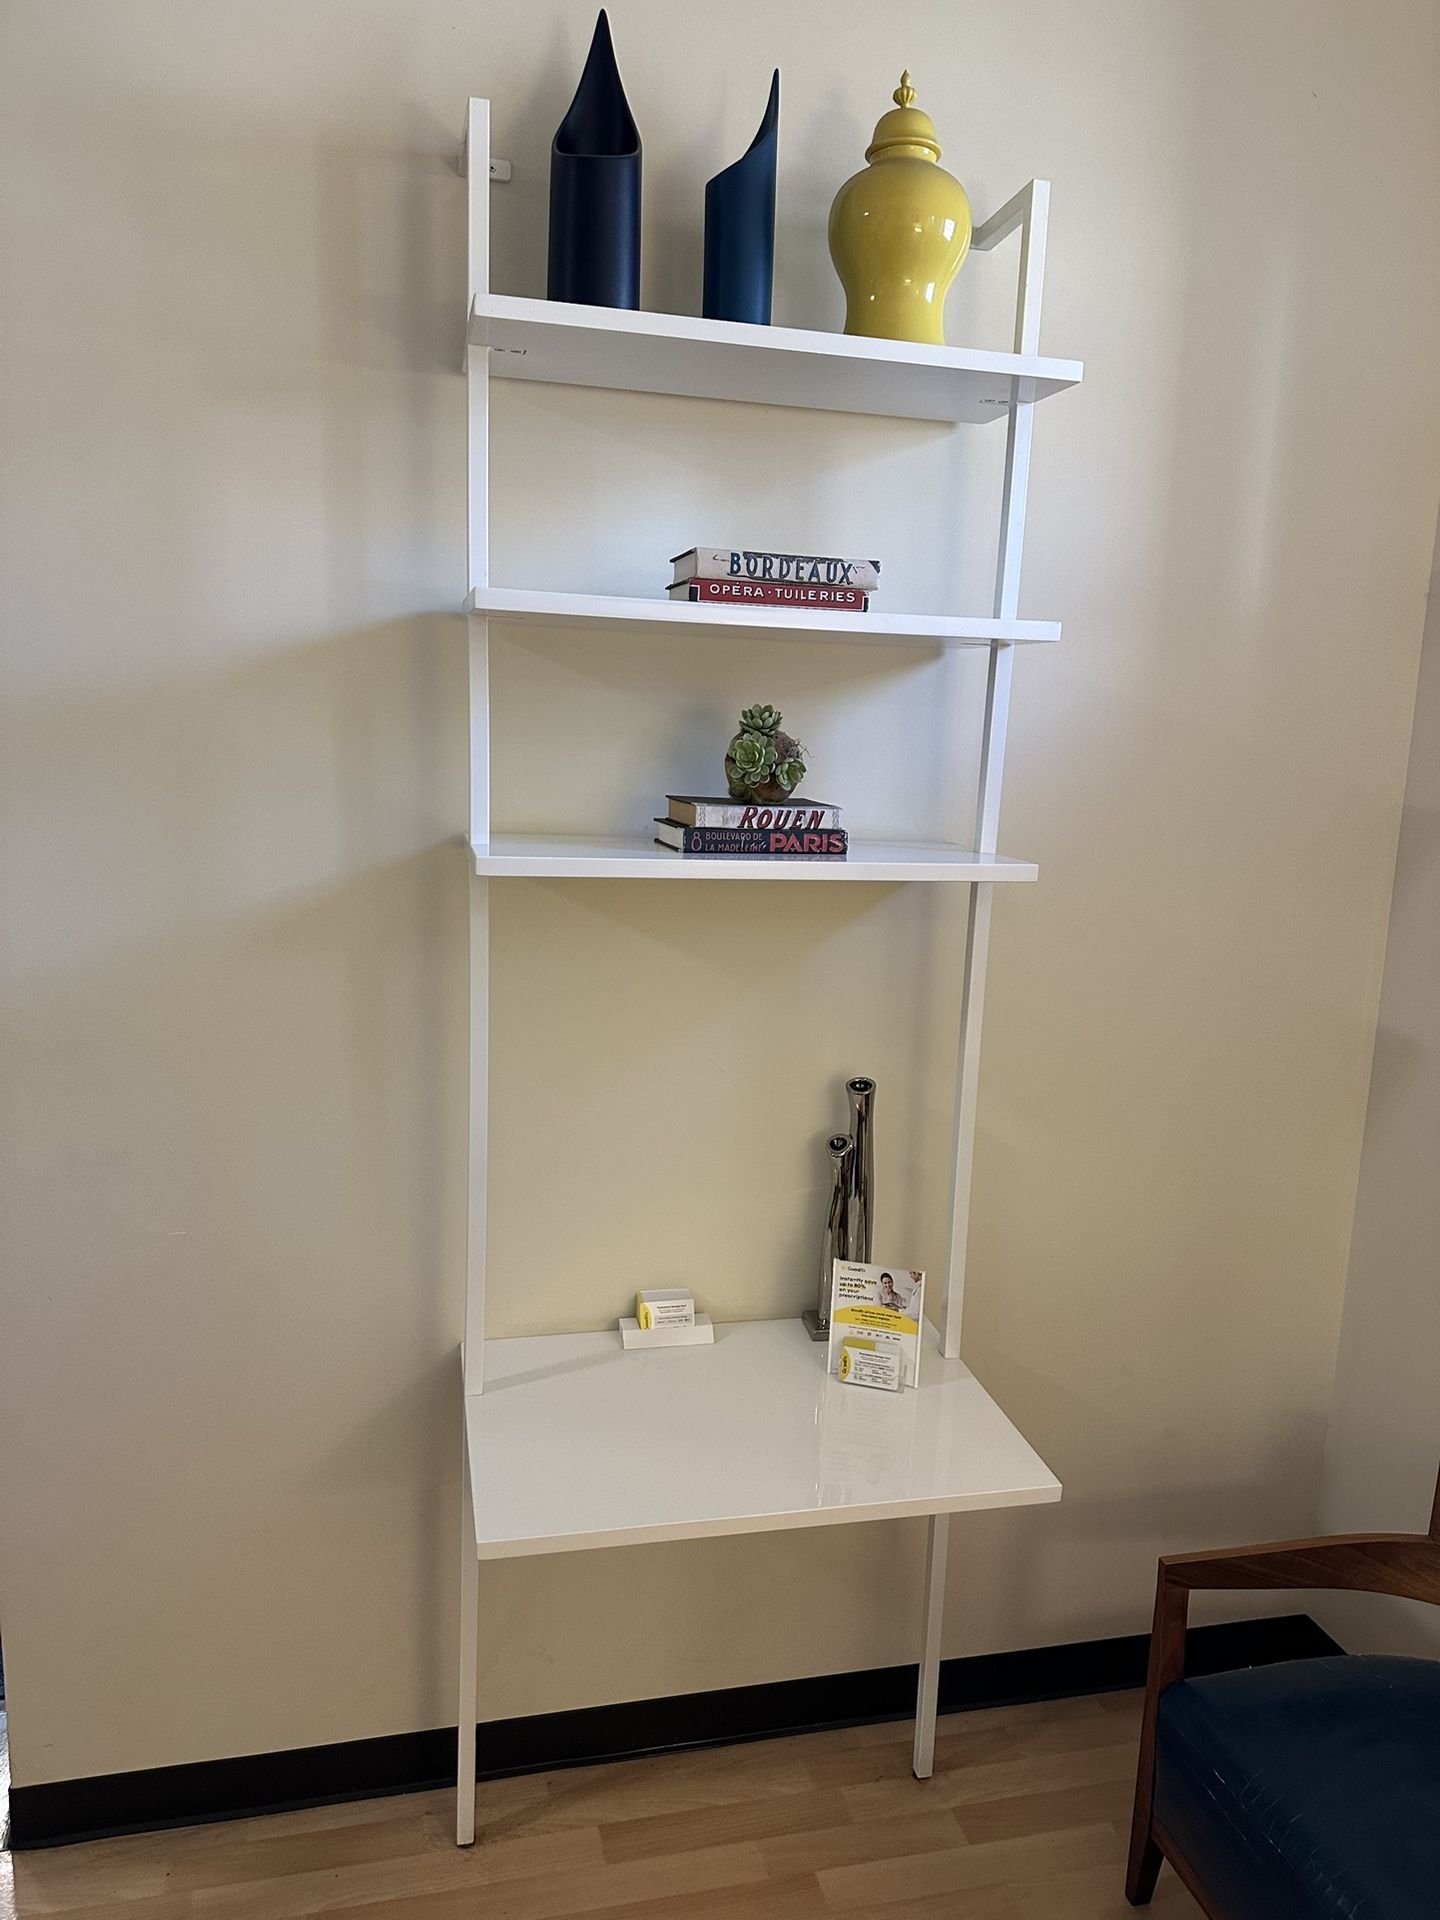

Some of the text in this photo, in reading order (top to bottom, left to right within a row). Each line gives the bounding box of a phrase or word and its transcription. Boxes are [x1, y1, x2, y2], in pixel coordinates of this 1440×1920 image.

[730, 552, 854, 585] BORDEAUX
[709, 581, 856, 602] OPÉRA TUILERIES
[737, 806, 826, 830] ROUEN
[691, 831, 702, 851] 8
[705, 831, 763, 841] BOULEVARD DE
[769, 832, 845, 852] PARIS
[705, 843, 763, 852] LA MADELEINE
